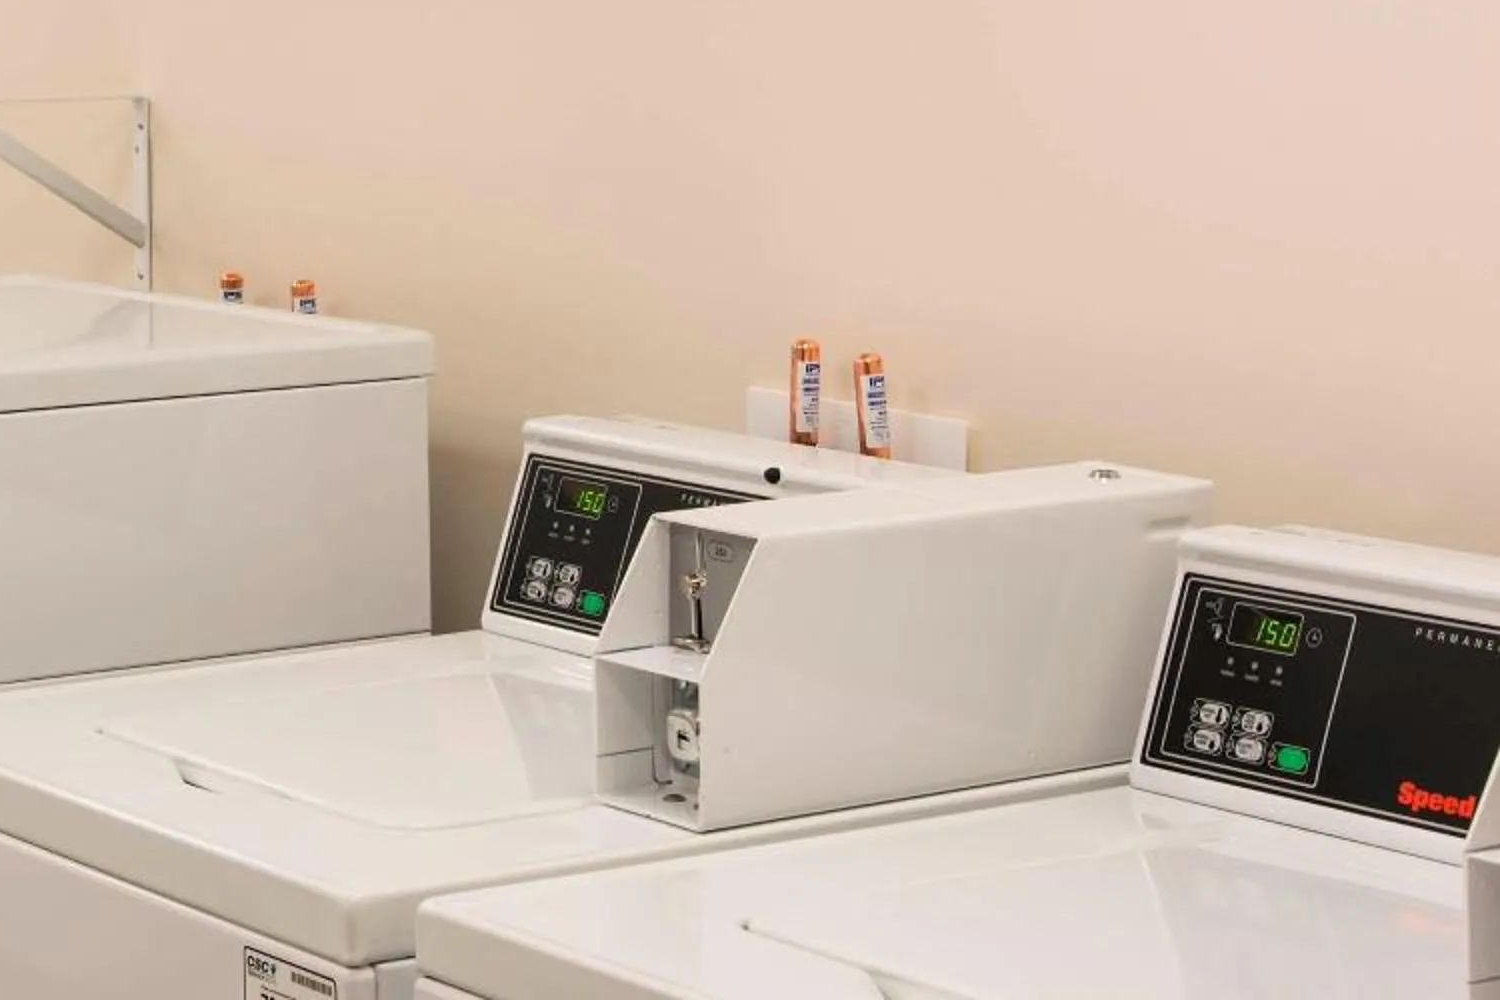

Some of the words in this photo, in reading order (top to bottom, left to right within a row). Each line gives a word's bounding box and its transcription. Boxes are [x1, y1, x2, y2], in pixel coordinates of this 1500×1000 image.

[577, 491, 605, 513] 150
[1256, 617, 1297, 648] 150
[1398, 782, 1476, 819] Speed
